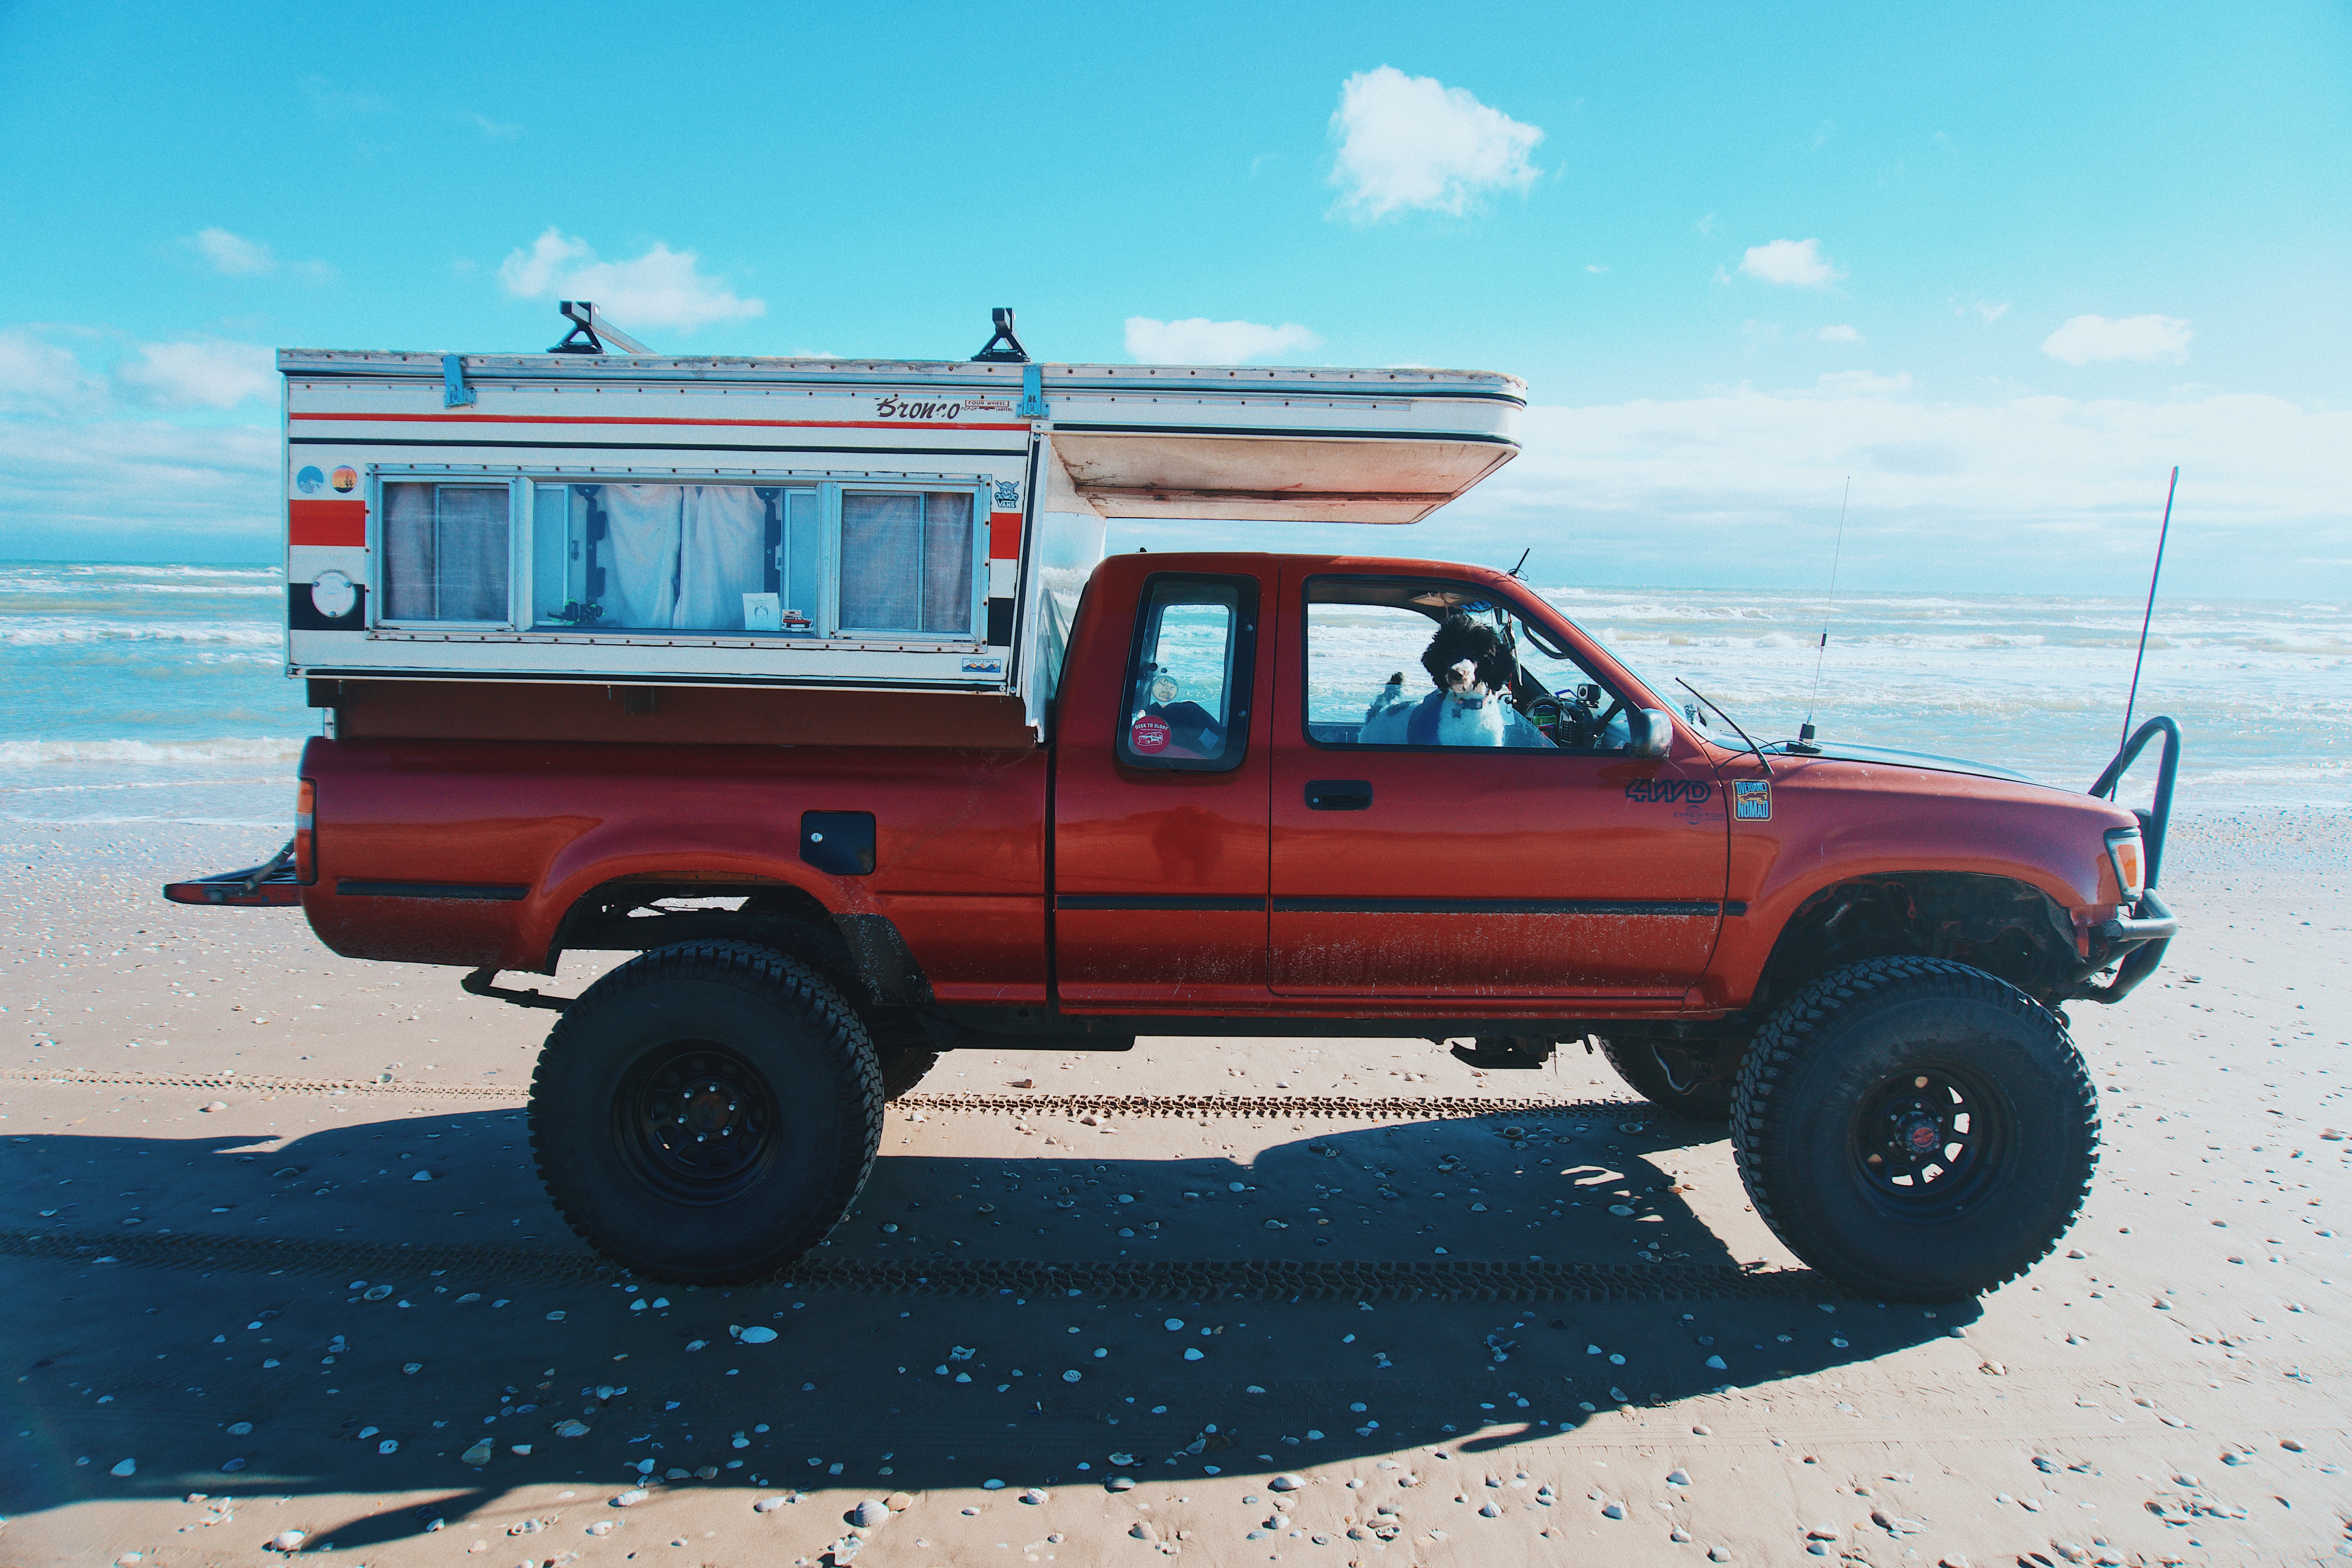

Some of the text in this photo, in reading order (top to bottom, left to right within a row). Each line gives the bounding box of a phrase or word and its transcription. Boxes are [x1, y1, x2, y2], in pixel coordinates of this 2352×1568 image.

[874, 398, 960, 419] Bronco
[1626, 779, 1711, 803] 4WD
[1736, 782, 1767, 795] OVERLAND
[1738, 800, 1768, 817] NOMAD
